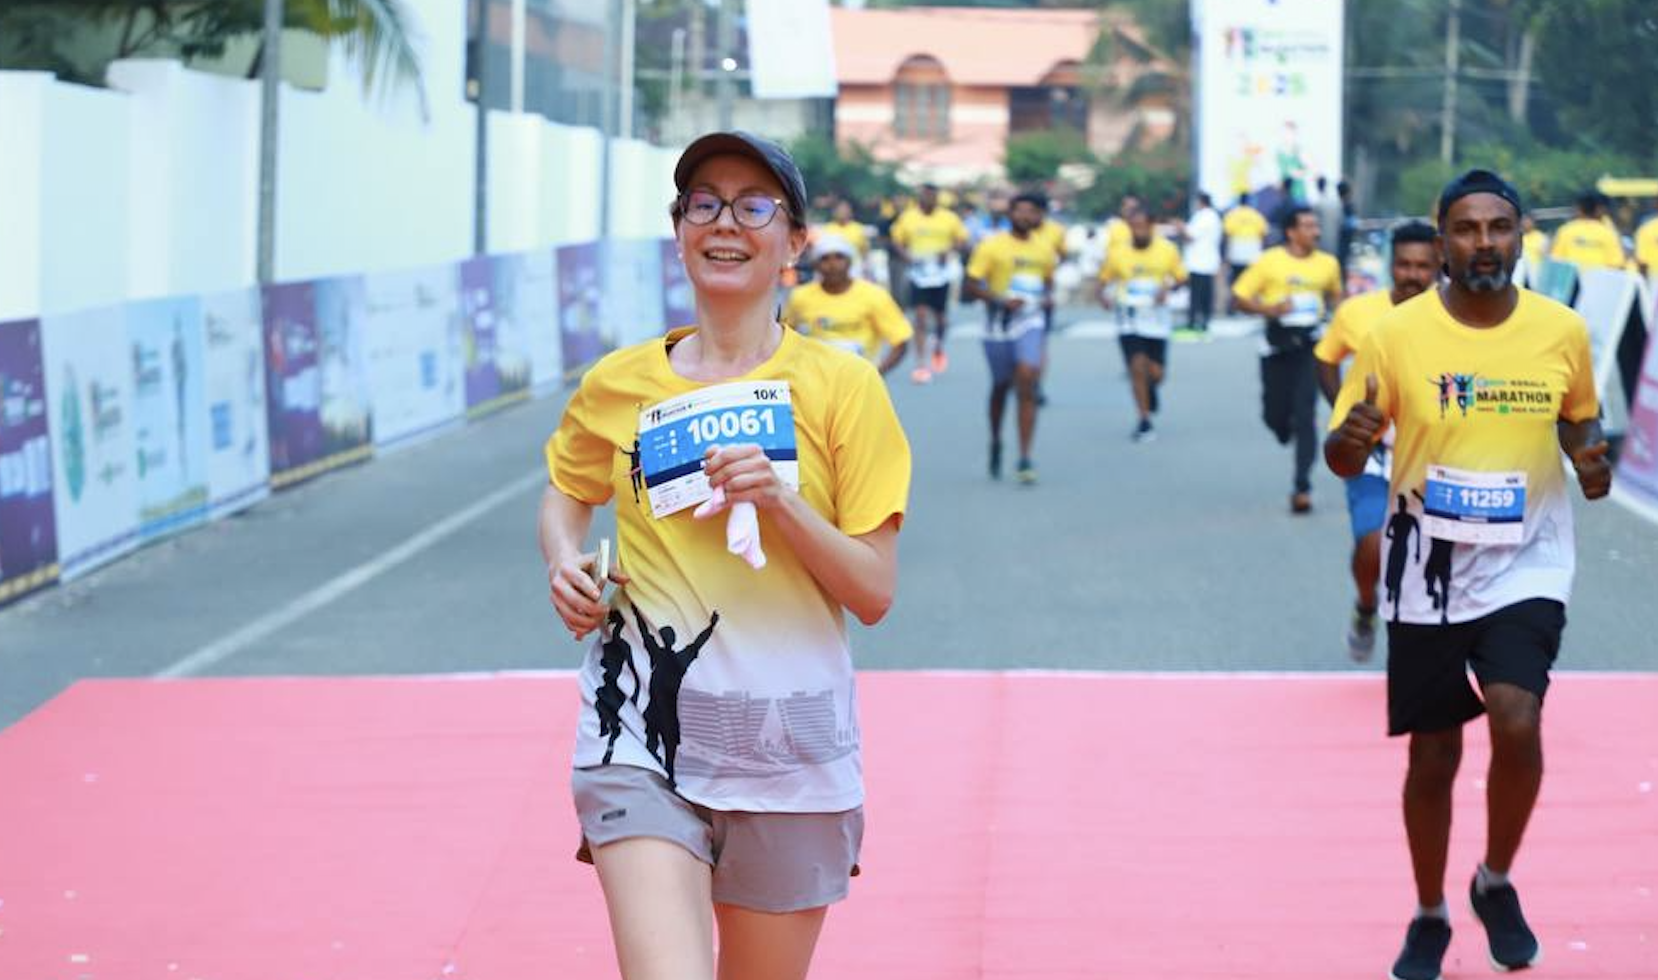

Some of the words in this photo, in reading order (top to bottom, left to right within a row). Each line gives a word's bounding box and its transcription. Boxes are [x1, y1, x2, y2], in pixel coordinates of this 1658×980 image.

[754, 389, 778, 400] 10K
[1476, 391, 1552, 403] MARATHON
[687, 408, 776, 444] 10061
[1460, 489, 1515, 508] 11259
